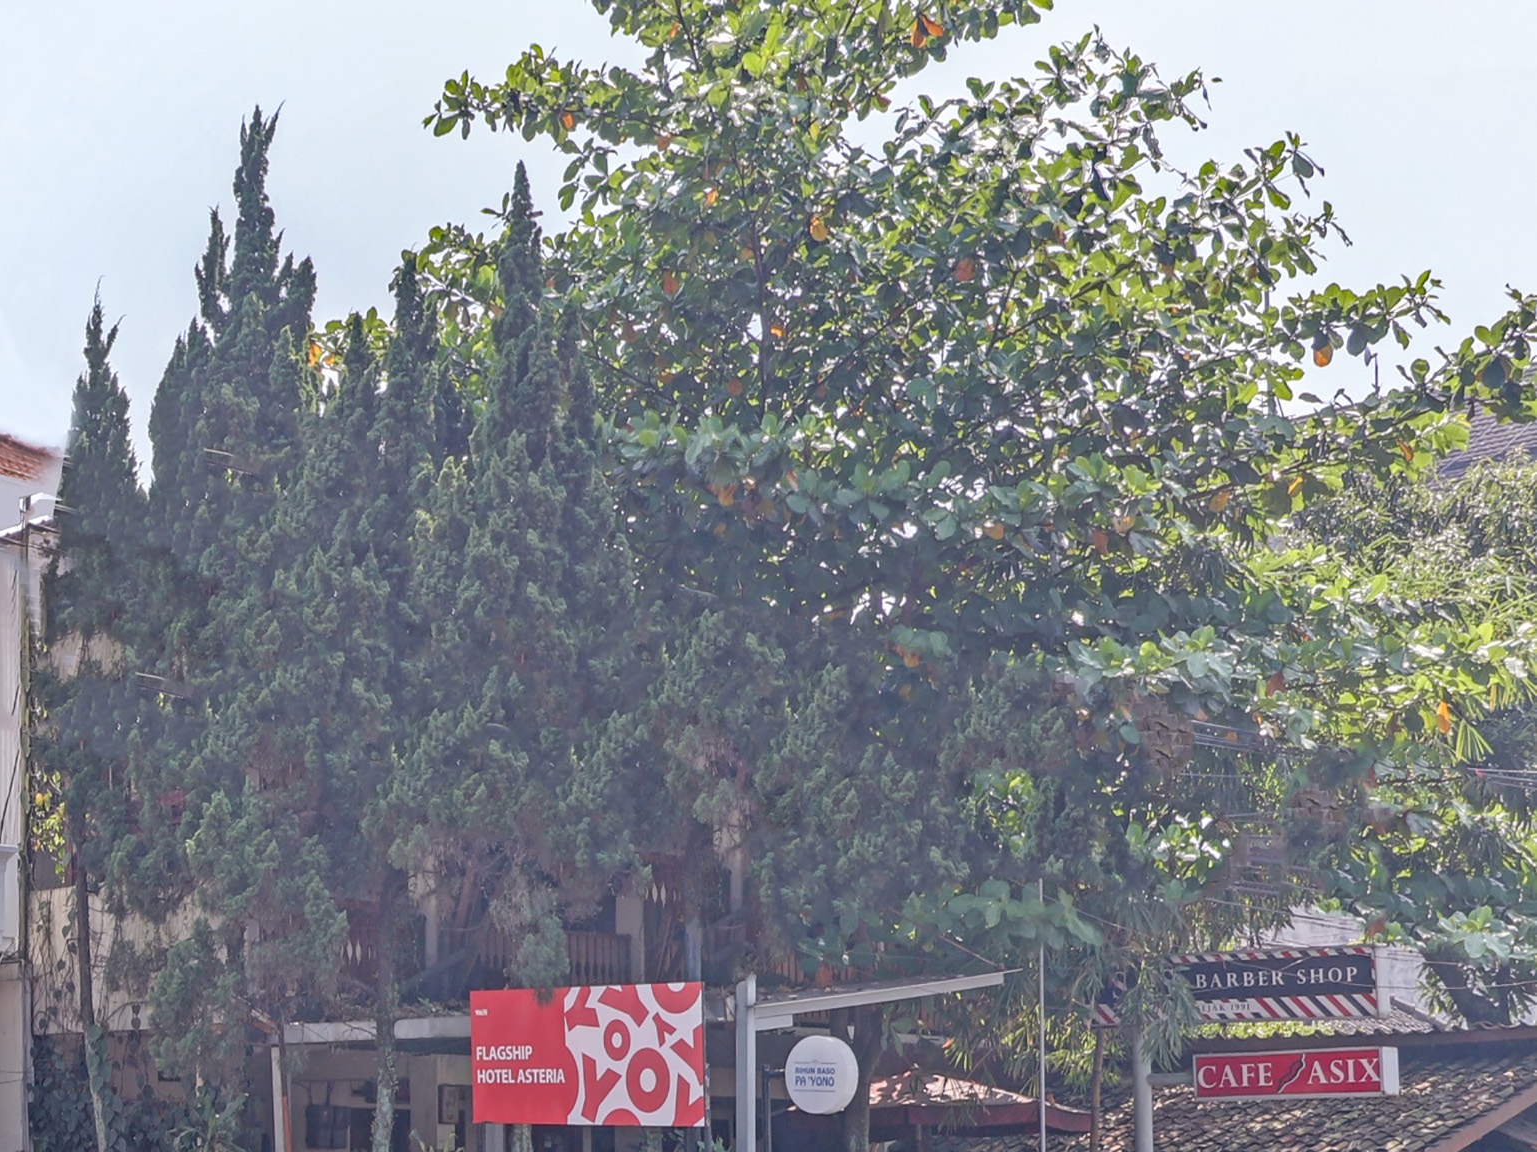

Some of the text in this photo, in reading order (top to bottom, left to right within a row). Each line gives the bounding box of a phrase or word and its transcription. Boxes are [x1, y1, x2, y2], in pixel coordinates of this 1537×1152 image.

[1195, 966, 1358, 990] BARBER SHOP
[1229, 1003, 1251, 1012] 1991
[475, 1045, 533, 1061] FLAGSHIP
[477, 1068, 566, 1084] HOTEL ASTERIA
[816, 1067, 836, 1075] BASO
[1197, 1057, 1381, 1089] CAFE ASIX
[794, 1075, 807, 1087] PA
